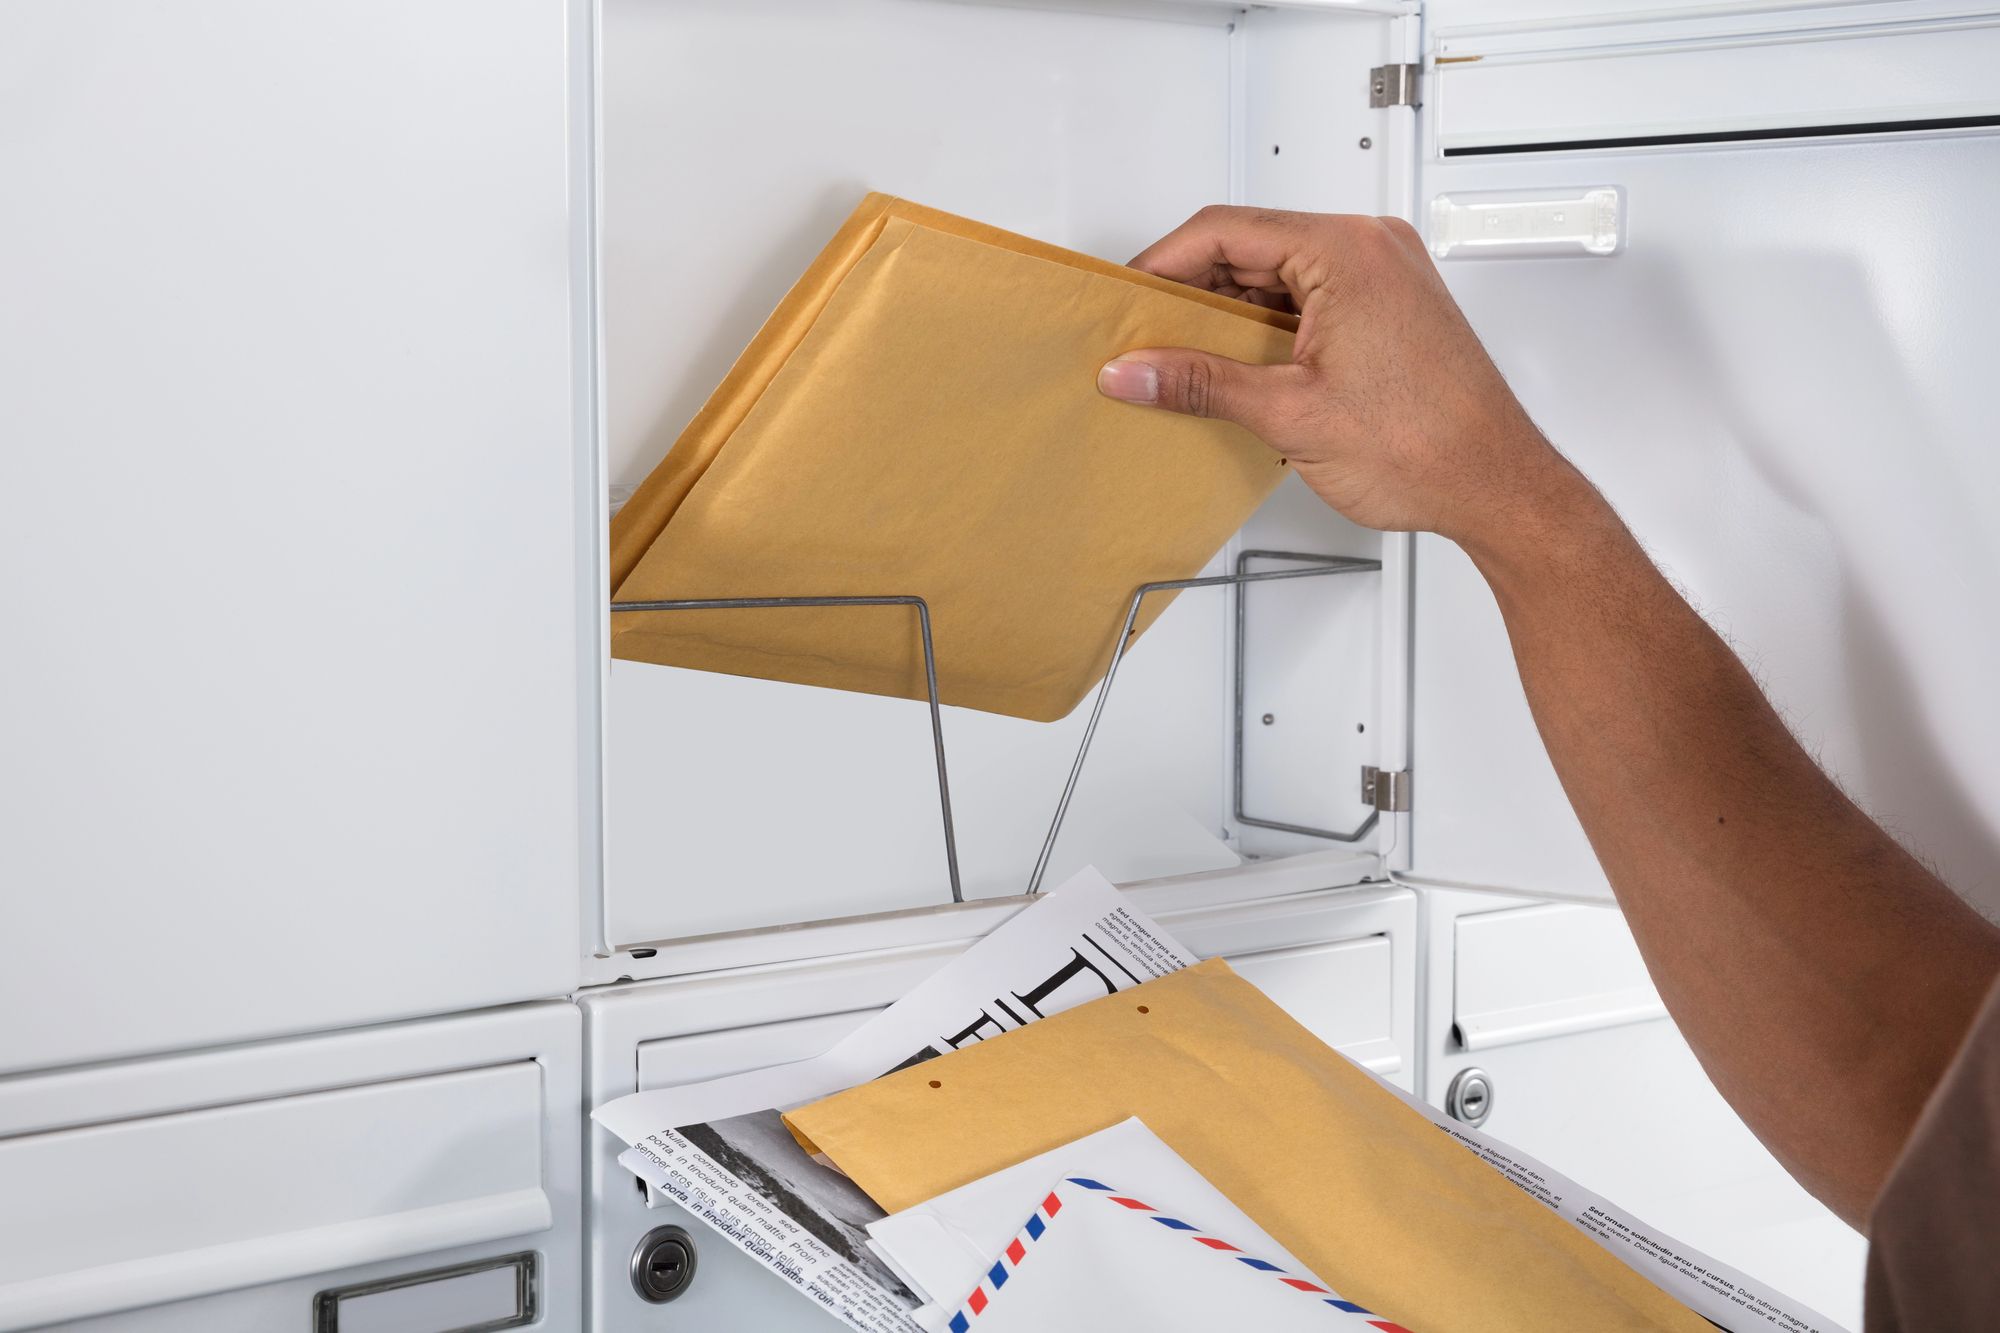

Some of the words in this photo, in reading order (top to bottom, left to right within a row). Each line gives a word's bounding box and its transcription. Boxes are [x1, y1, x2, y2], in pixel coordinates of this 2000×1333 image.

[1095, 921, 1133, 955] condimentum
[1102, 917, 1122, 935] magna
[1130, 940, 1154, 962] vehicula
[1109, 912, 1132, 932] egestas
[1131, 931, 1145, 943] felis
[1116, 907, 1130, 919] Sed
[1128, 918, 1152, 939] congue
[1151, 937, 1170, 955] turpis
[1451, 1131, 1483, 1150] rhoncus.
[1485, 1147, 1512, 1164] Aliquam
[1512, 1162, 1528, 1173] erat
[634, 1142, 672, 1170] semper
[669, 1169, 693, 1189] eros
[720, 1208, 741, 1227] quis
[741, 1223, 777, 1252] tempor
[645, 1134, 674, 1157] porta,
[676, 1155, 688, 1165] in
[687, 1164, 729, 1196] tincidunt
[728, 1195, 756, 1217] quam
[789, 1242, 817, 1265] Proin
[662, 1129, 687, 1149] Nulla
[692, 1153, 739, 1189] commodo
[744, 1193, 773, 1214] lorem
[779, 1219, 800, 1234] sed
[803, 1238, 830, 1258] nunc
[1480, 1153, 1507, 1170] tempus
[1506, 1167, 1533, 1185] porttitor
[1553, 1195, 1562, 1203] et
[660, 1182, 688, 1204] porta,
[691, 1201, 703, 1212] in
[702, 1210, 746, 1242] tincidunt
[744, 1240, 774, 1262] quam
[1575, 1216, 1598, 1233] varius
[831, 1265, 850, 1280] amet
[849, 1279, 863, 1290] orci
[862, 1289, 883, 1306] mattis
[1581, 1211, 1607, 1228] blandit
[1633, 1241, 1659, 1258] Donec
[1658, 1255, 1679, 1270] ligula
[1679, 1267, 1700, 1282] dolor,
[1701, 1279, 1731, 1298] suscipit
[1730, 1295, 1746, 1306] sed
[1746, 1303, 1767, 1317] dolor
[1588, 1205, 1605, 1218] Sed
[1604, 1215, 1630, 1233] ornare
[1630, 1230, 1673, 1257] sollicitudin
[1673, 1254, 1693, 1268] arcu
[1693, 1264, 1707, 1275] vel
[1705, 1271, 1736, 1292] cursus.
[1737, 1287, 1756, 1301] Duis
[1756, 1298, 1782, 1316] rutrum
[1782, 1312, 1809, 1331] magna
[816, 1274, 842, 1295] suscipit
[841, 1294, 858, 1307] eget
[857, 1306, 869, 1316] est
[824, 1269, 850, 1290] Aenean
[862, 1299, 877, 1311] sem
[880, 1313, 893, 1324] non
[880, 1293, 903, 1312] massa
